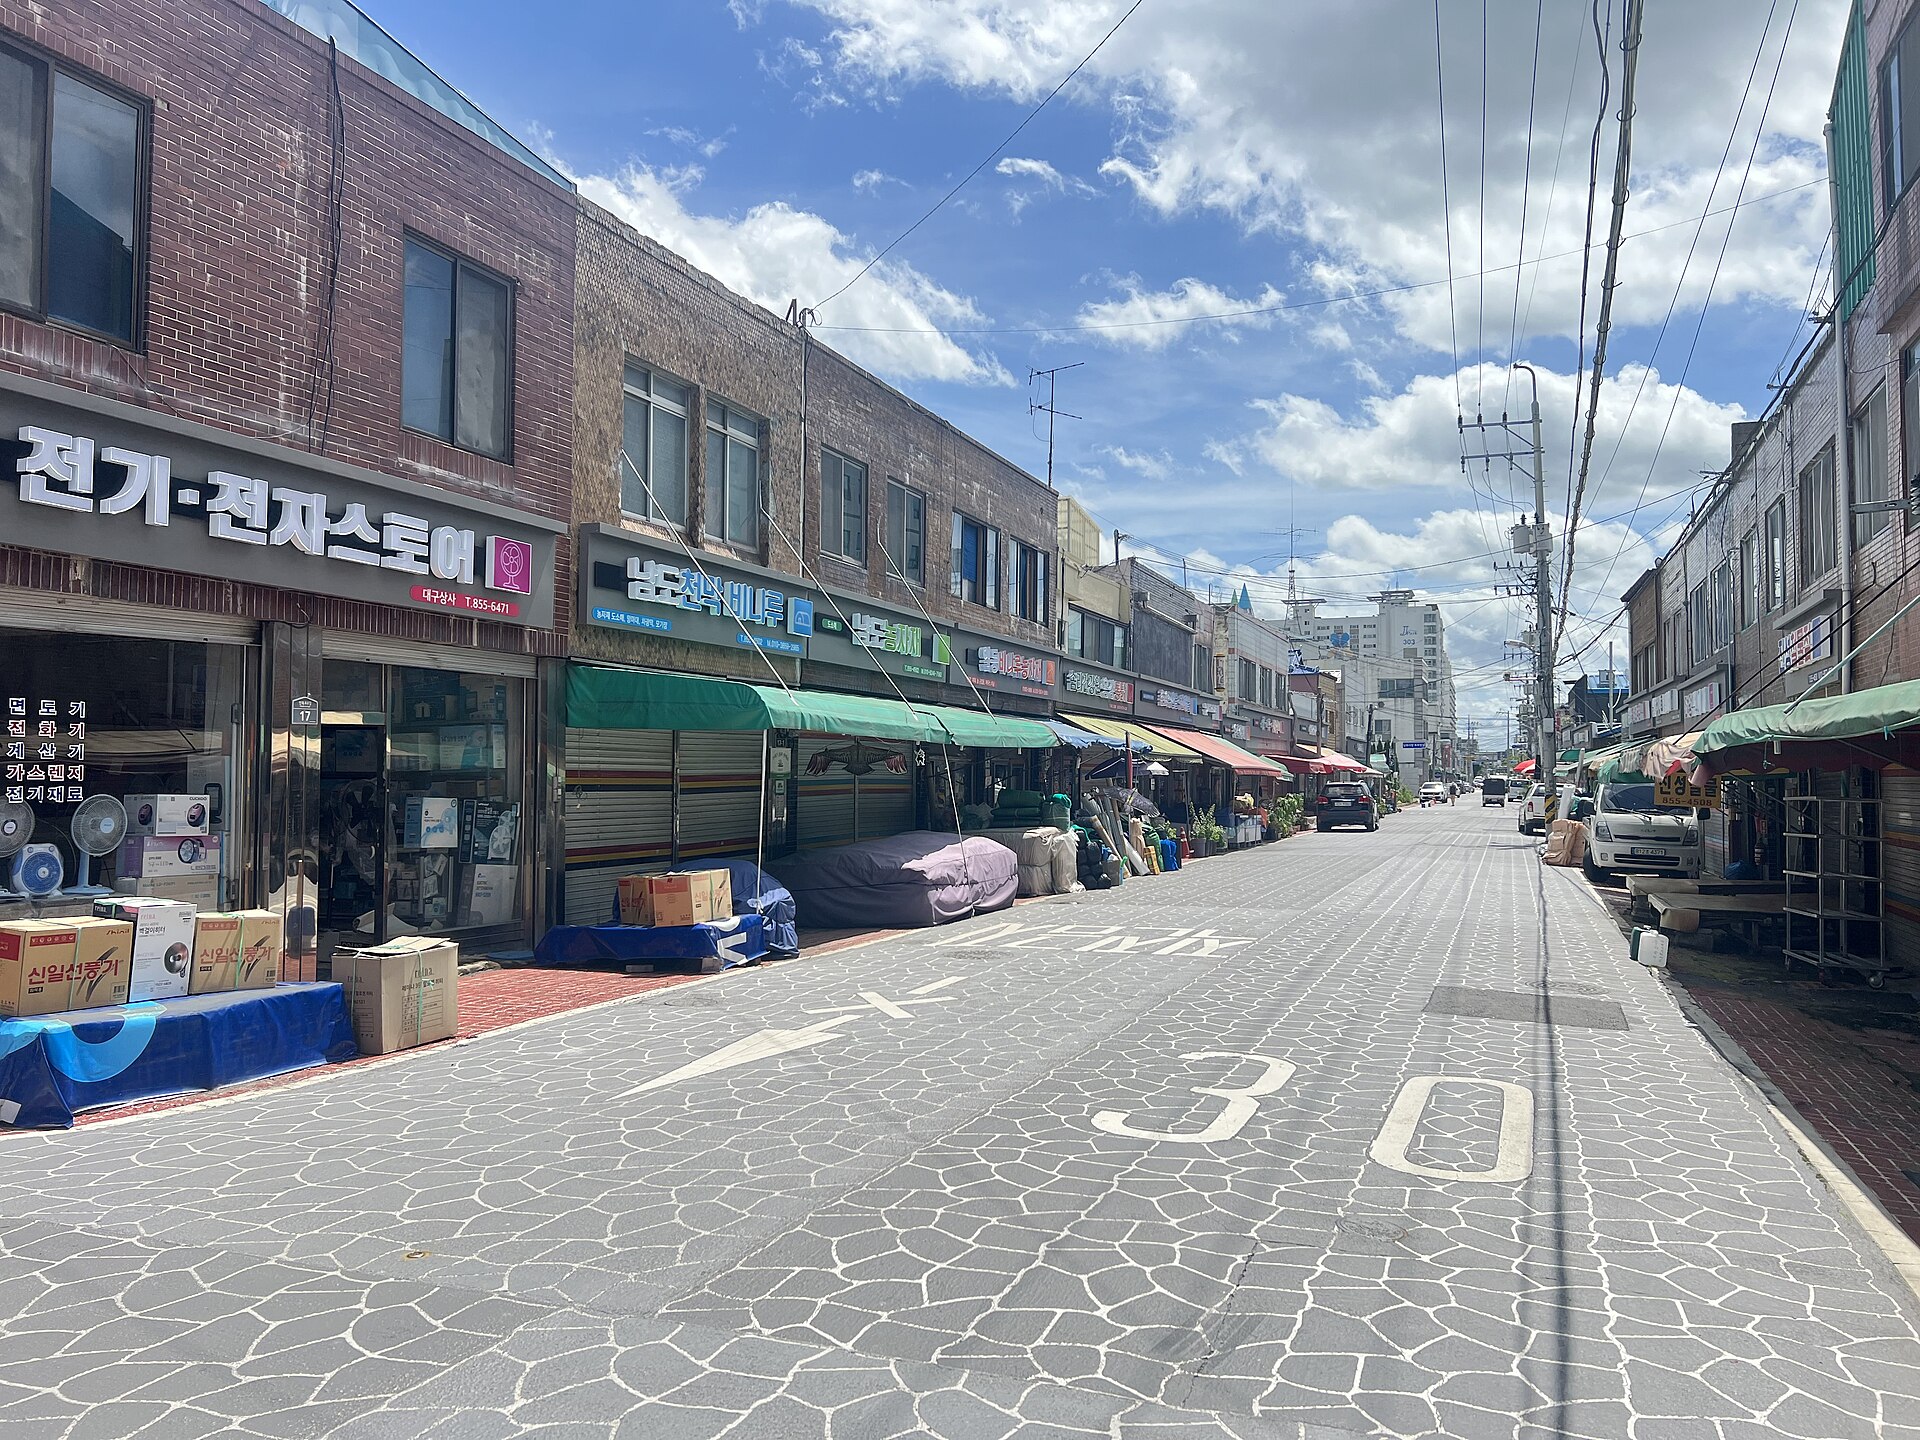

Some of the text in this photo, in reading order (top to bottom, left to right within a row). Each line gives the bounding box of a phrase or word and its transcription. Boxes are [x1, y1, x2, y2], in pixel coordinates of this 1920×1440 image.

[422, 588, 510, 614] 대구상사 T.855-6471
[299, 710, 311, 722] 17
[5, 764, 84, 781] 가스렌지
[5, 786, 84, 803] 전기재료
[1662, 797, 1712, 806] 855-4508
[200, 946, 271, 964] 신일선풍기
[28, 959, 119, 985] 신일선풍기
[1091, 1051, 1534, 1184] 30
